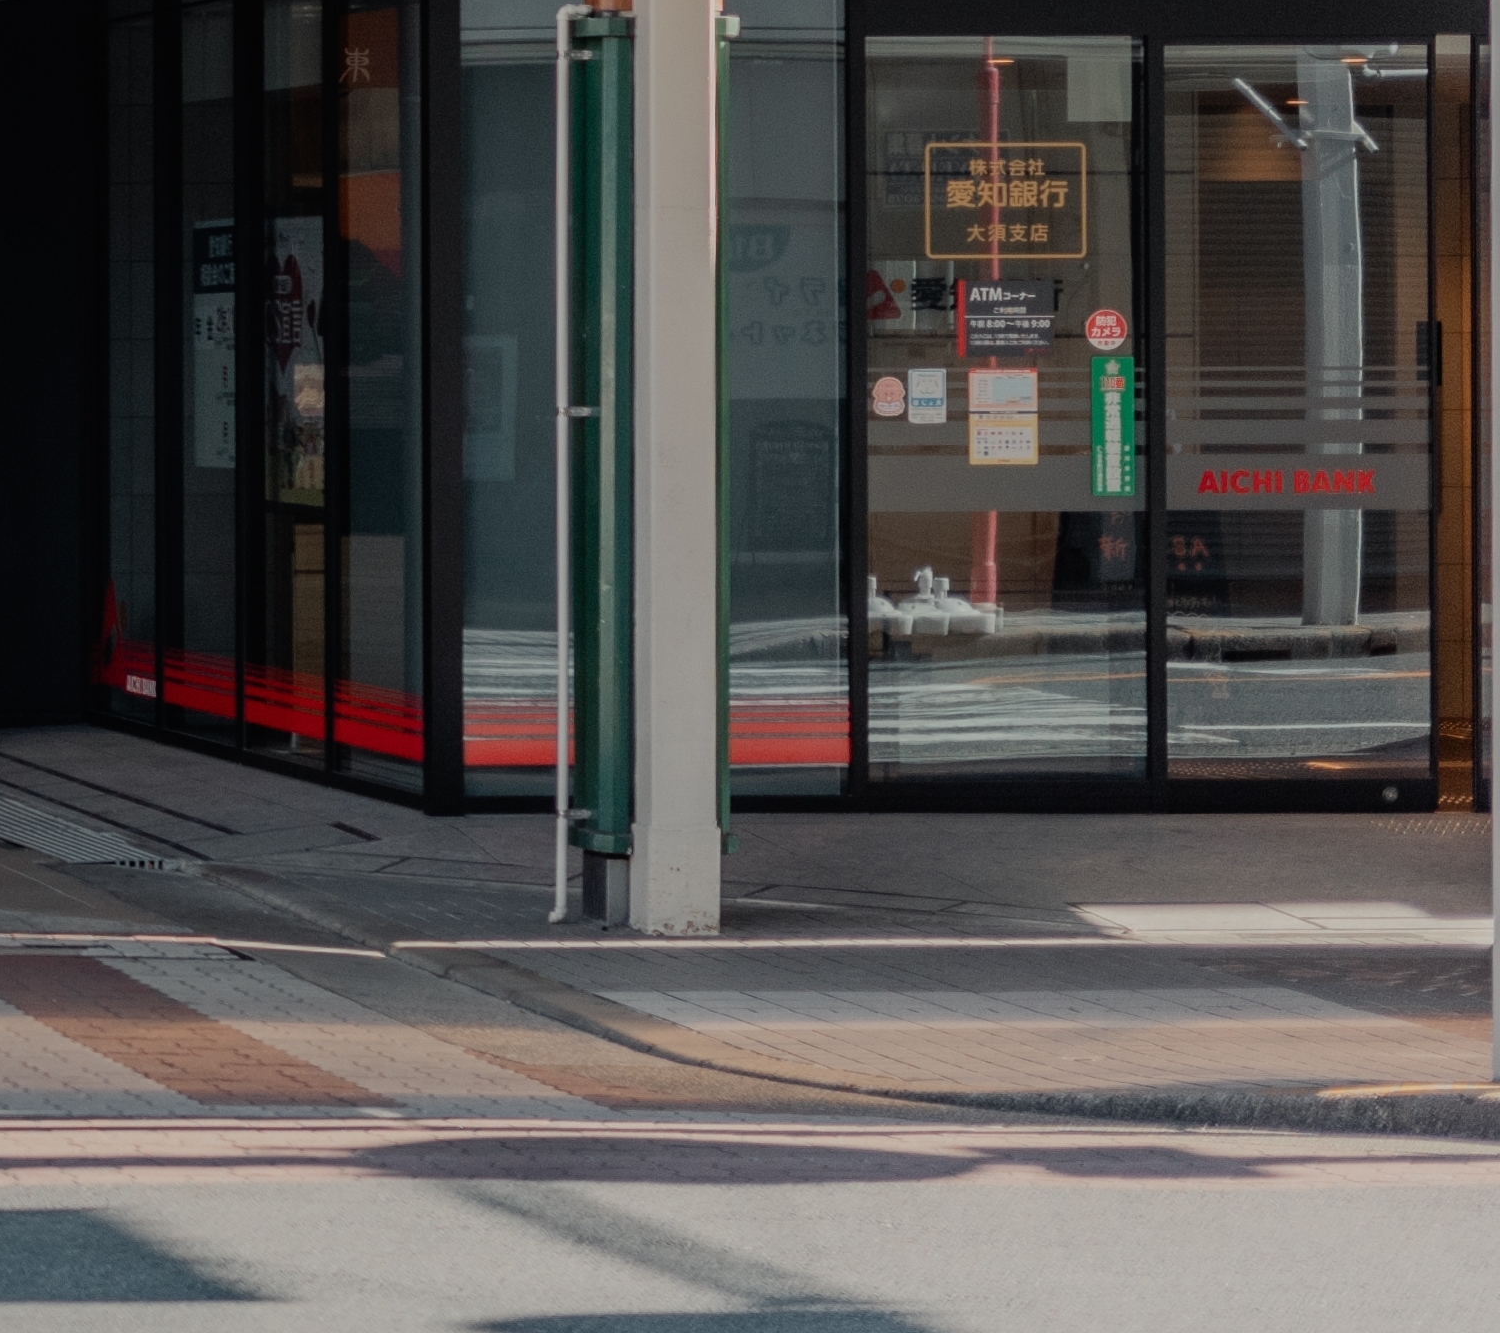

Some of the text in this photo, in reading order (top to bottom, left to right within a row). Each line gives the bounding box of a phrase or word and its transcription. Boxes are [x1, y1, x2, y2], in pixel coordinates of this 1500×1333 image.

[968, 158, 1046, 176] 株式会社
[945, 179, 1069, 208] 愛知銀行
[966, 223, 1049, 243] 大須支店
[969, 287, 1037, 302] ATMコーナー
[1095, 315, 1117, 326] 防犯
[1091, 327, 1122, 337] カメラ
[1197, 469, 1376, 494] AICHI BANK
